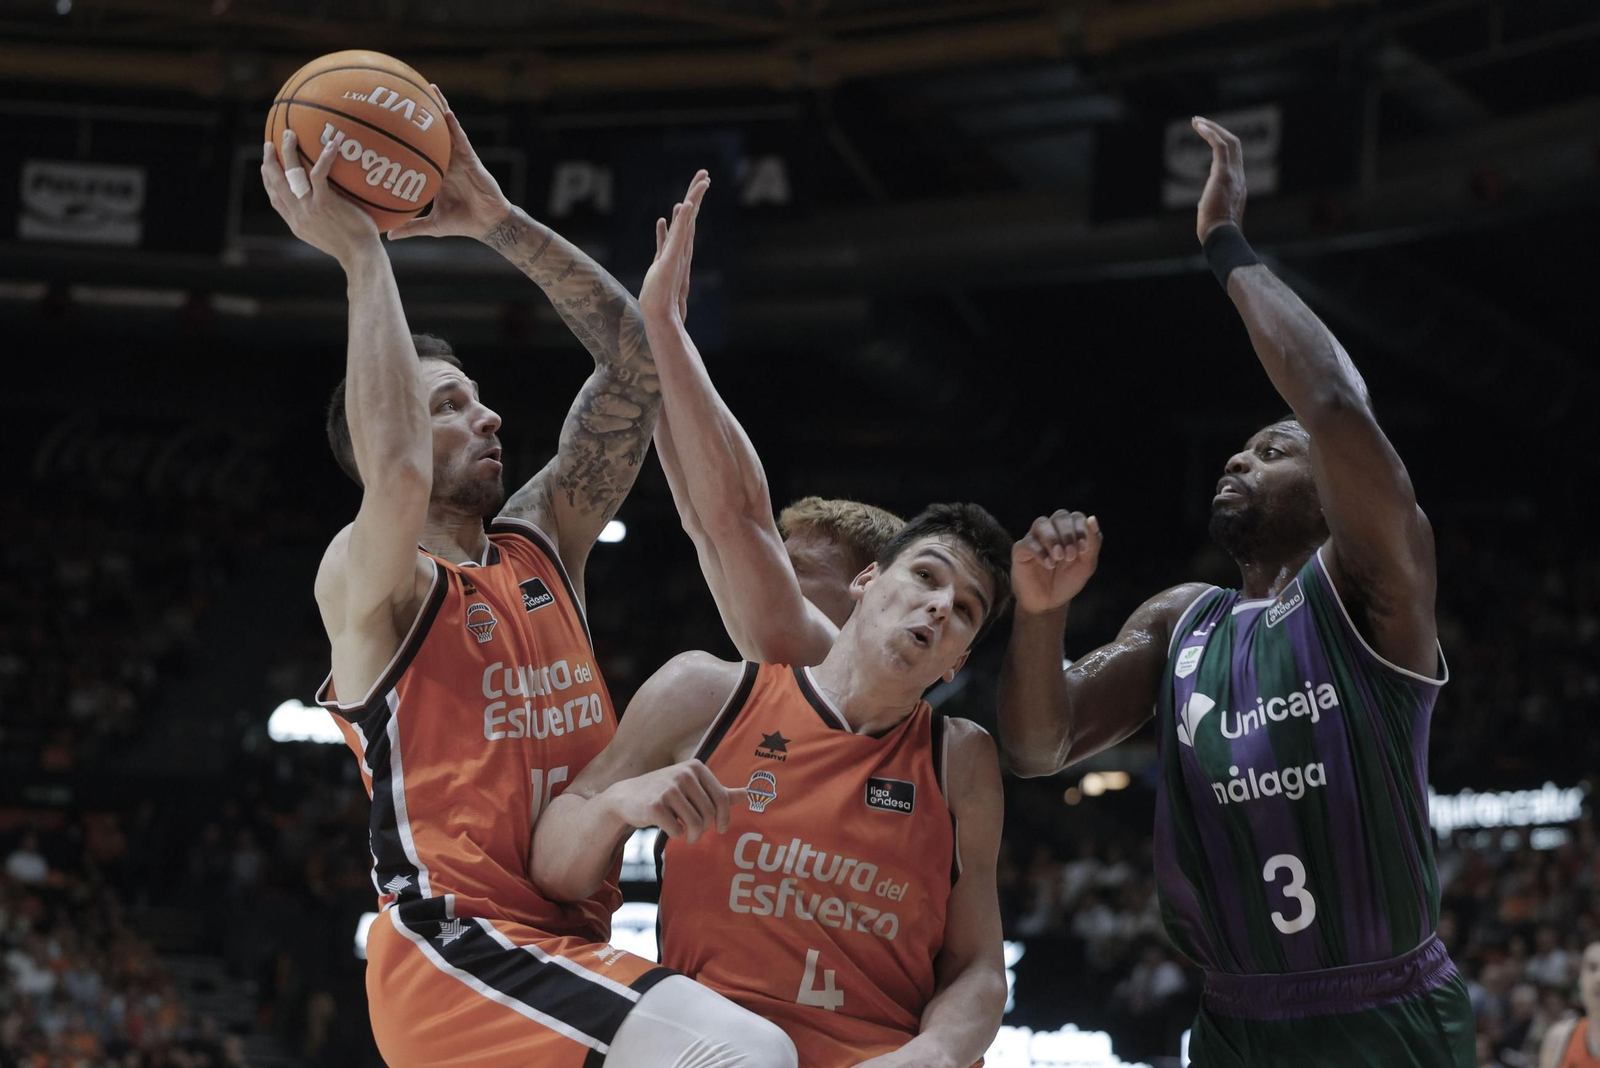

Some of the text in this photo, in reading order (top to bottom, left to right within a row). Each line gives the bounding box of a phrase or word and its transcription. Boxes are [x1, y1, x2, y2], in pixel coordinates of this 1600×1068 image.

[341, 86, 434, 131] EVO NXT
[319, 122, 427, 203] Wilson
[523, 593, 551, 608] ndesa
[574, 662, 593, 684] del
[1220, 681, 1339, 739] Unicaja
[754, 749, 787, 762] luanvi
[870, 786, 890, 797] liga
[870, 796, 911, 811] endesa
[733, 832, 909, 901] Cultura del
[729, 873, 899, 941] Esfuerzo
[1263, 853, 1316, 934] 3
[796, 948, 844, 1011] 4
